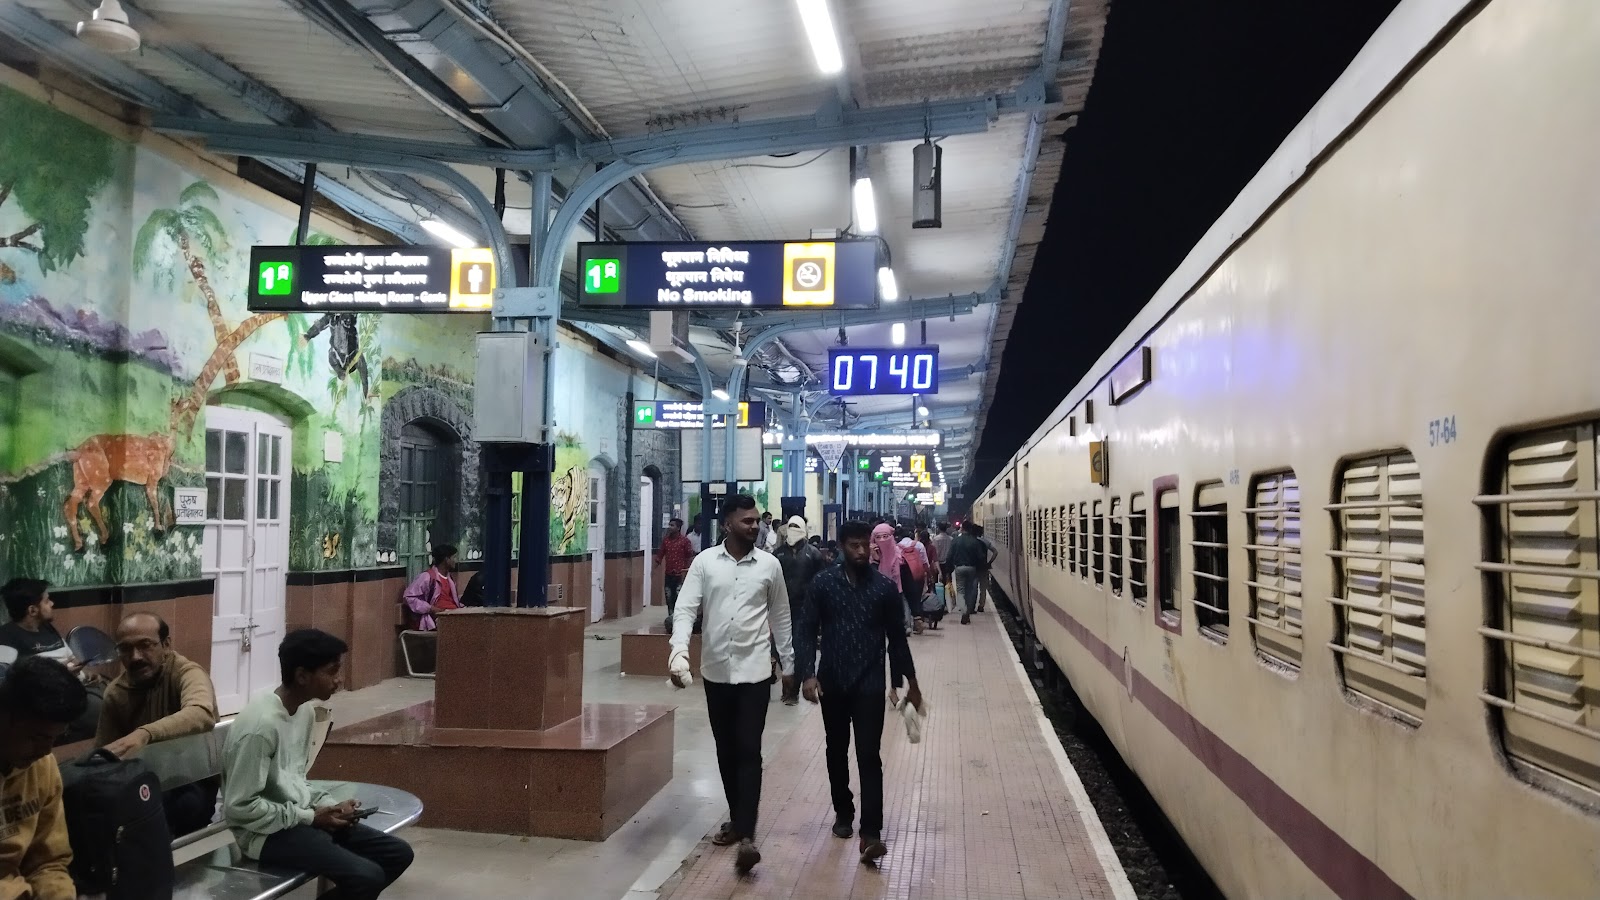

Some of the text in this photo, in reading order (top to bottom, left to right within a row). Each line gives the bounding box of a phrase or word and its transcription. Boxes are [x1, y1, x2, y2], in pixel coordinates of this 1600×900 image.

[388, 291, 414, 302] Room
[658, 288, 752, 305] No Smoking
[1429, 414, 1457, 447] 57-64
